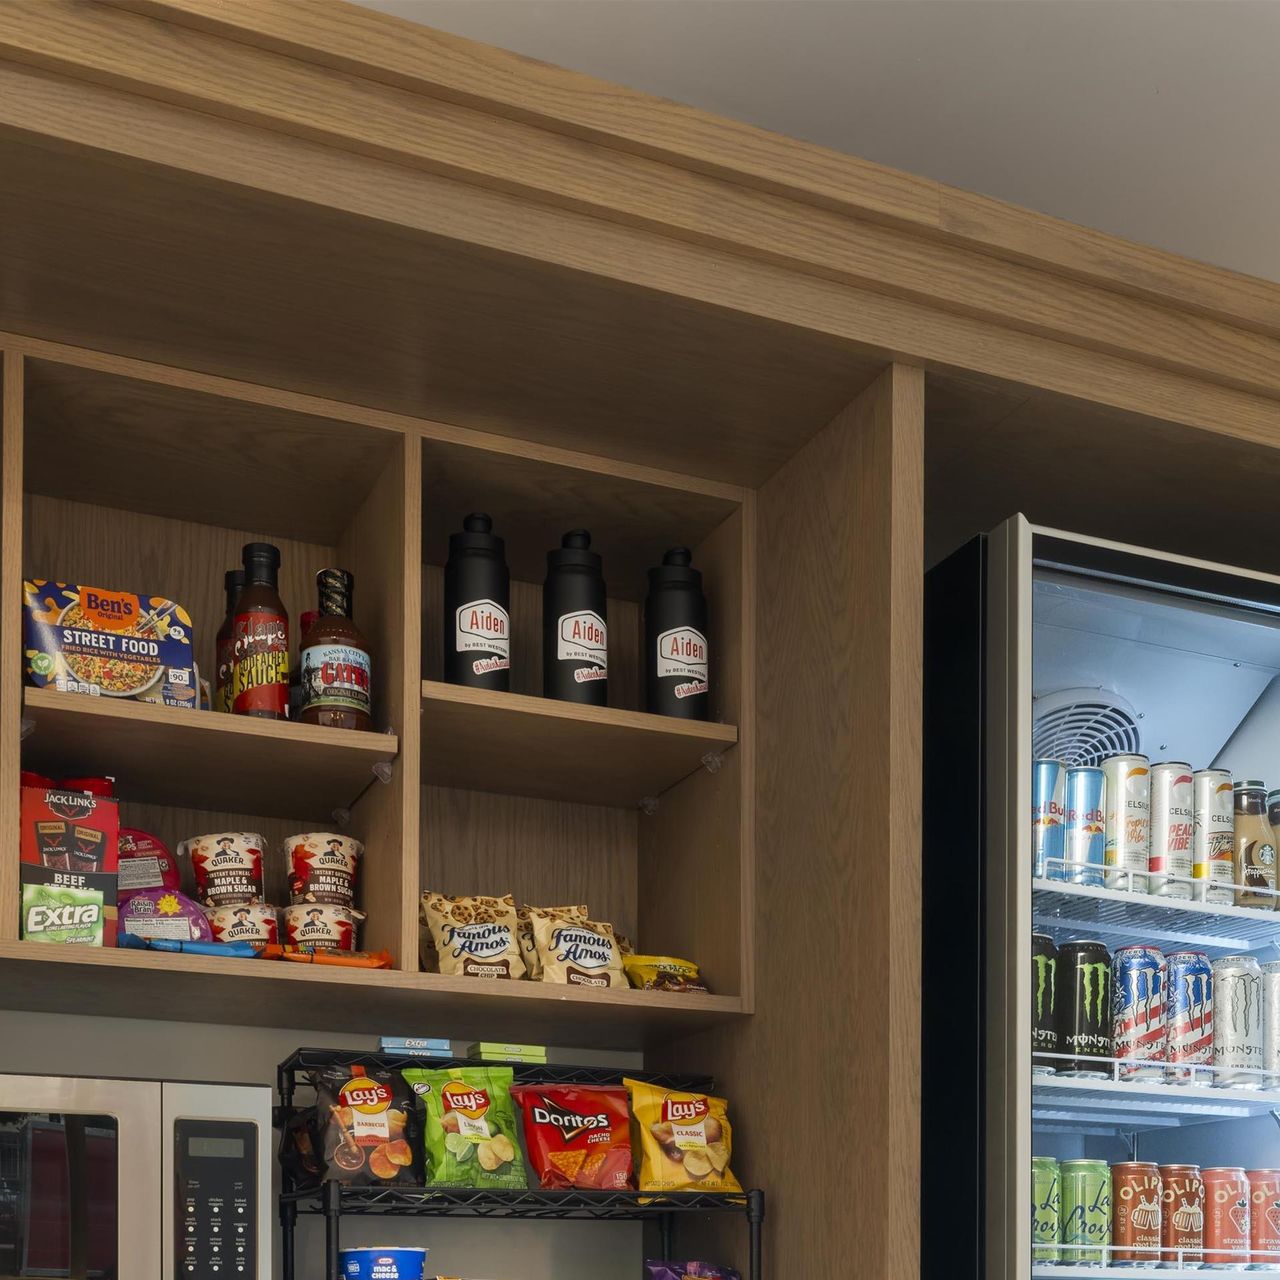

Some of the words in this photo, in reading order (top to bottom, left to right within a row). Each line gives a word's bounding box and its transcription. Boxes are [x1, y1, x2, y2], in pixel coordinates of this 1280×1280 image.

[87, 593, 133, 615] Ben's
[97, 612, 123, 620] Original
[470, 610, 504, 635] Aiden
[573, 620, 604, 644] Aiden
[63, 630, 116, 649] STREET
[122, 639, 159, 655] FOOD
[670, 636, 704, 659] Aiden
[99, 649, 117, 657] WITH
[119, 652, 161, 662] VEGETABLES
[239, 651, 286, 673] GODFATHER
[239, 664, 280, 692] SAUCE
[44, 792, 68, 804] JACK
[69, 795, 96, 808] LINK'S
[76, 829, 99, 839] ORIGINAL
[1168, 837, 1189, 851] VIBE
[211, 856, 244, 866] QUAKER
[319, 857, 348, 867] QUAKER
[54, 874, 85, 884] BEEF
[214, 877, 240, 885] MAPLE
[310, 884, 336, 892] BROWN
[319, 876, 340, 885] MAPLE
[208, 886, 232, 895] BROWN
[234, 885, 256, 893] SUGAR
[28, 905, 99, 932] Extra
[228, 927, 261, 937] QUAKER
[300, 927, 332, 937] QUAKER
[442, 924, 510, 947] Famous
[549, 927, 612, 951] Famous
[452, 937, 510, 958] Amos
[556, 943, 610, 962] Amos
[571, 974, 607, 986] CHOCOLATE
[345, 1086, 387, 1105] Lay's
[446, 1092, 485, 1110] Lay's
[534, 1108, 609, 1128] Doritos
[668, 1100, 705, 1120] Lay's
[1088, 1180, 1110, 1215] La
